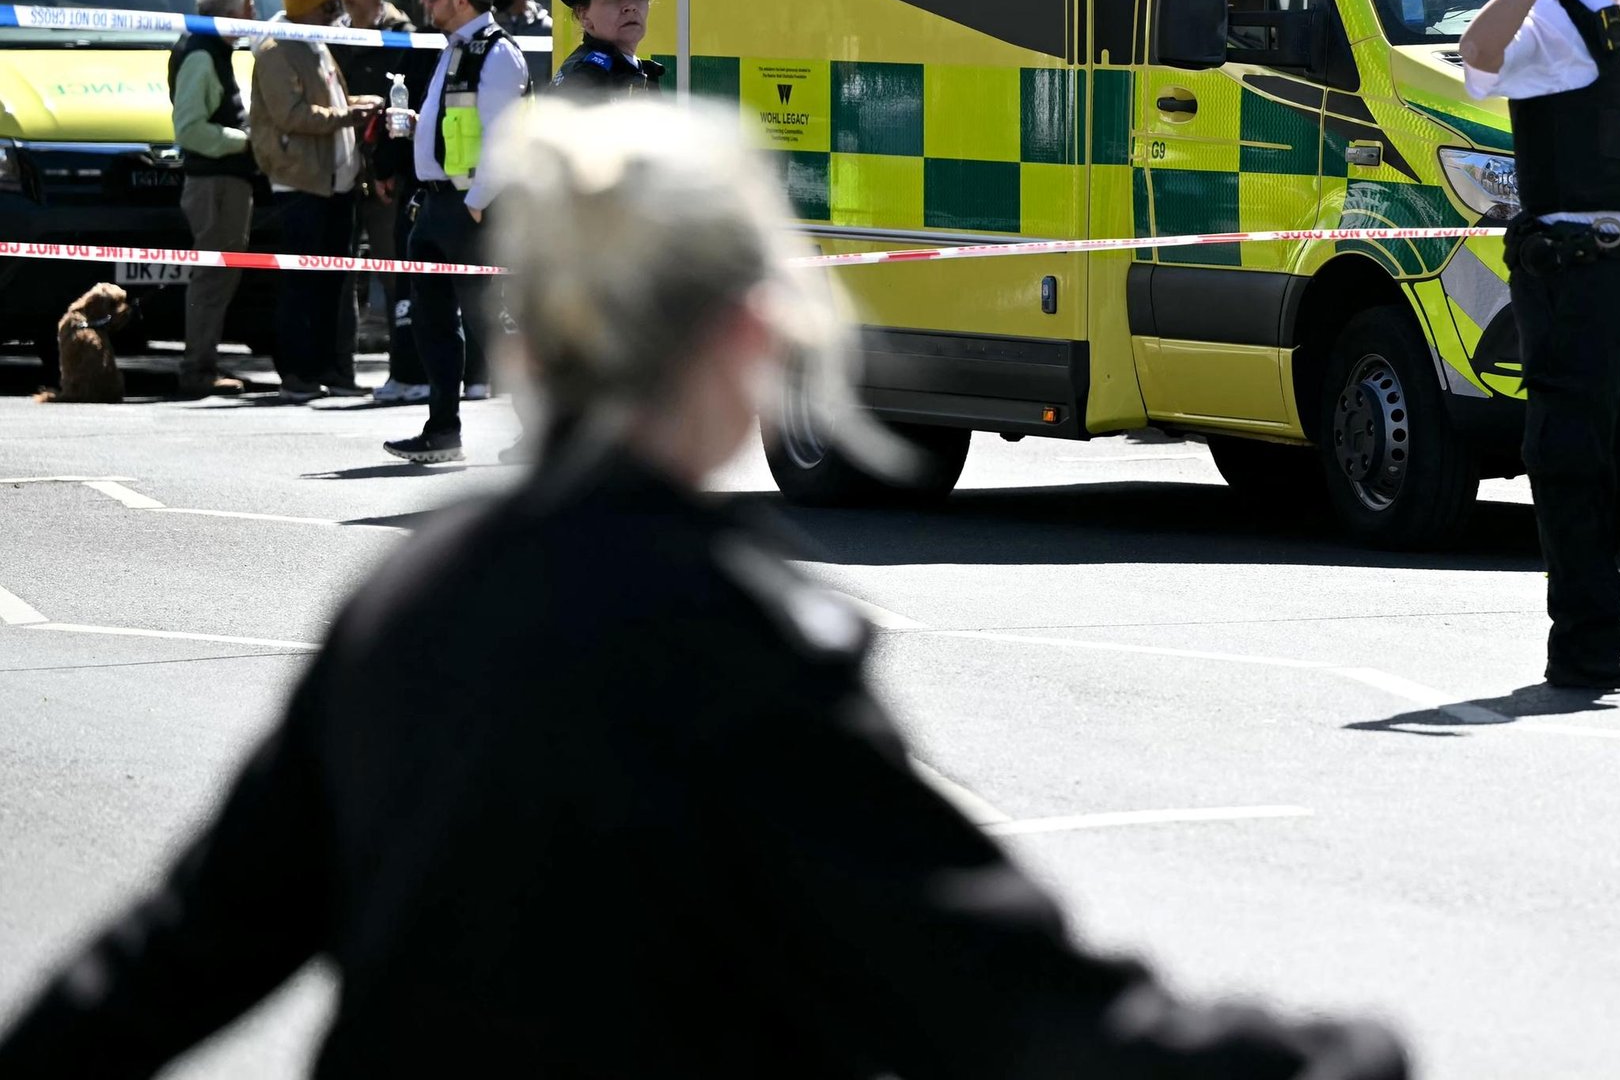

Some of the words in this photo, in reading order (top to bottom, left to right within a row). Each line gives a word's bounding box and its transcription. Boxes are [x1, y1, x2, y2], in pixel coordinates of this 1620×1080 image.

[760, 112, 781, 124] WOHL
[783, 113, 810, 125] LEGACY
[1151, 141, 1166, 160] G9
